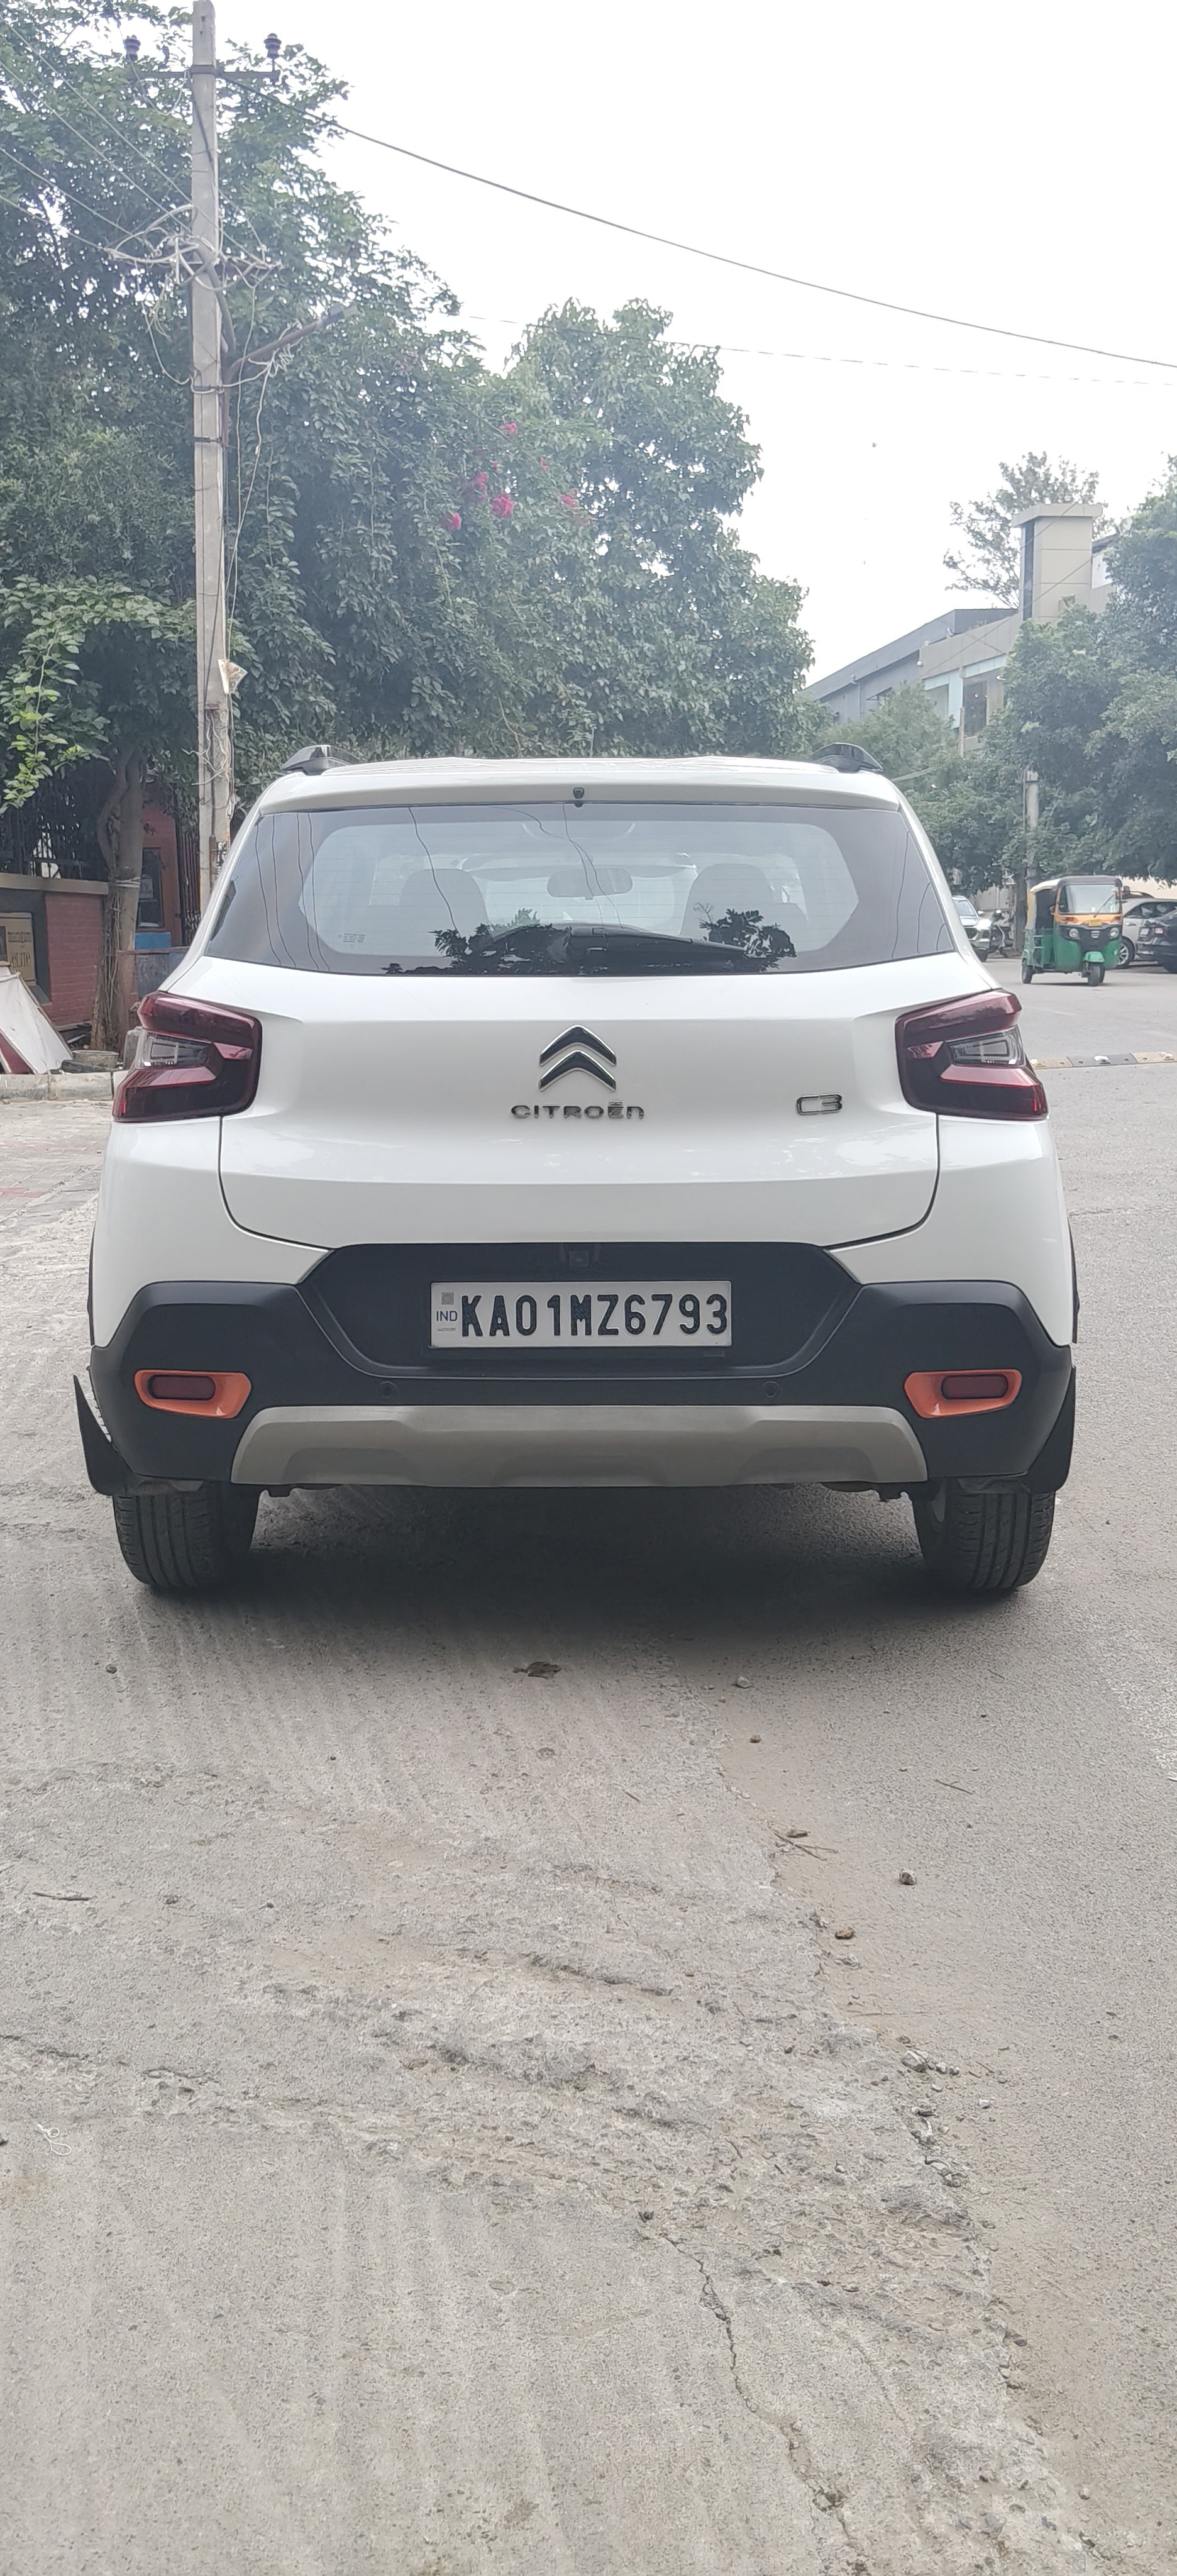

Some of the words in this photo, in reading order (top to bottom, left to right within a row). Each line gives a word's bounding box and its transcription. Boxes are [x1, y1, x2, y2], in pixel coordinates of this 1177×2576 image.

[796, 1093, 843, 1116] C3
[436, 1311, 458, 1321] IND
[461, 1294, 727, 1336] KA01MZ6793
